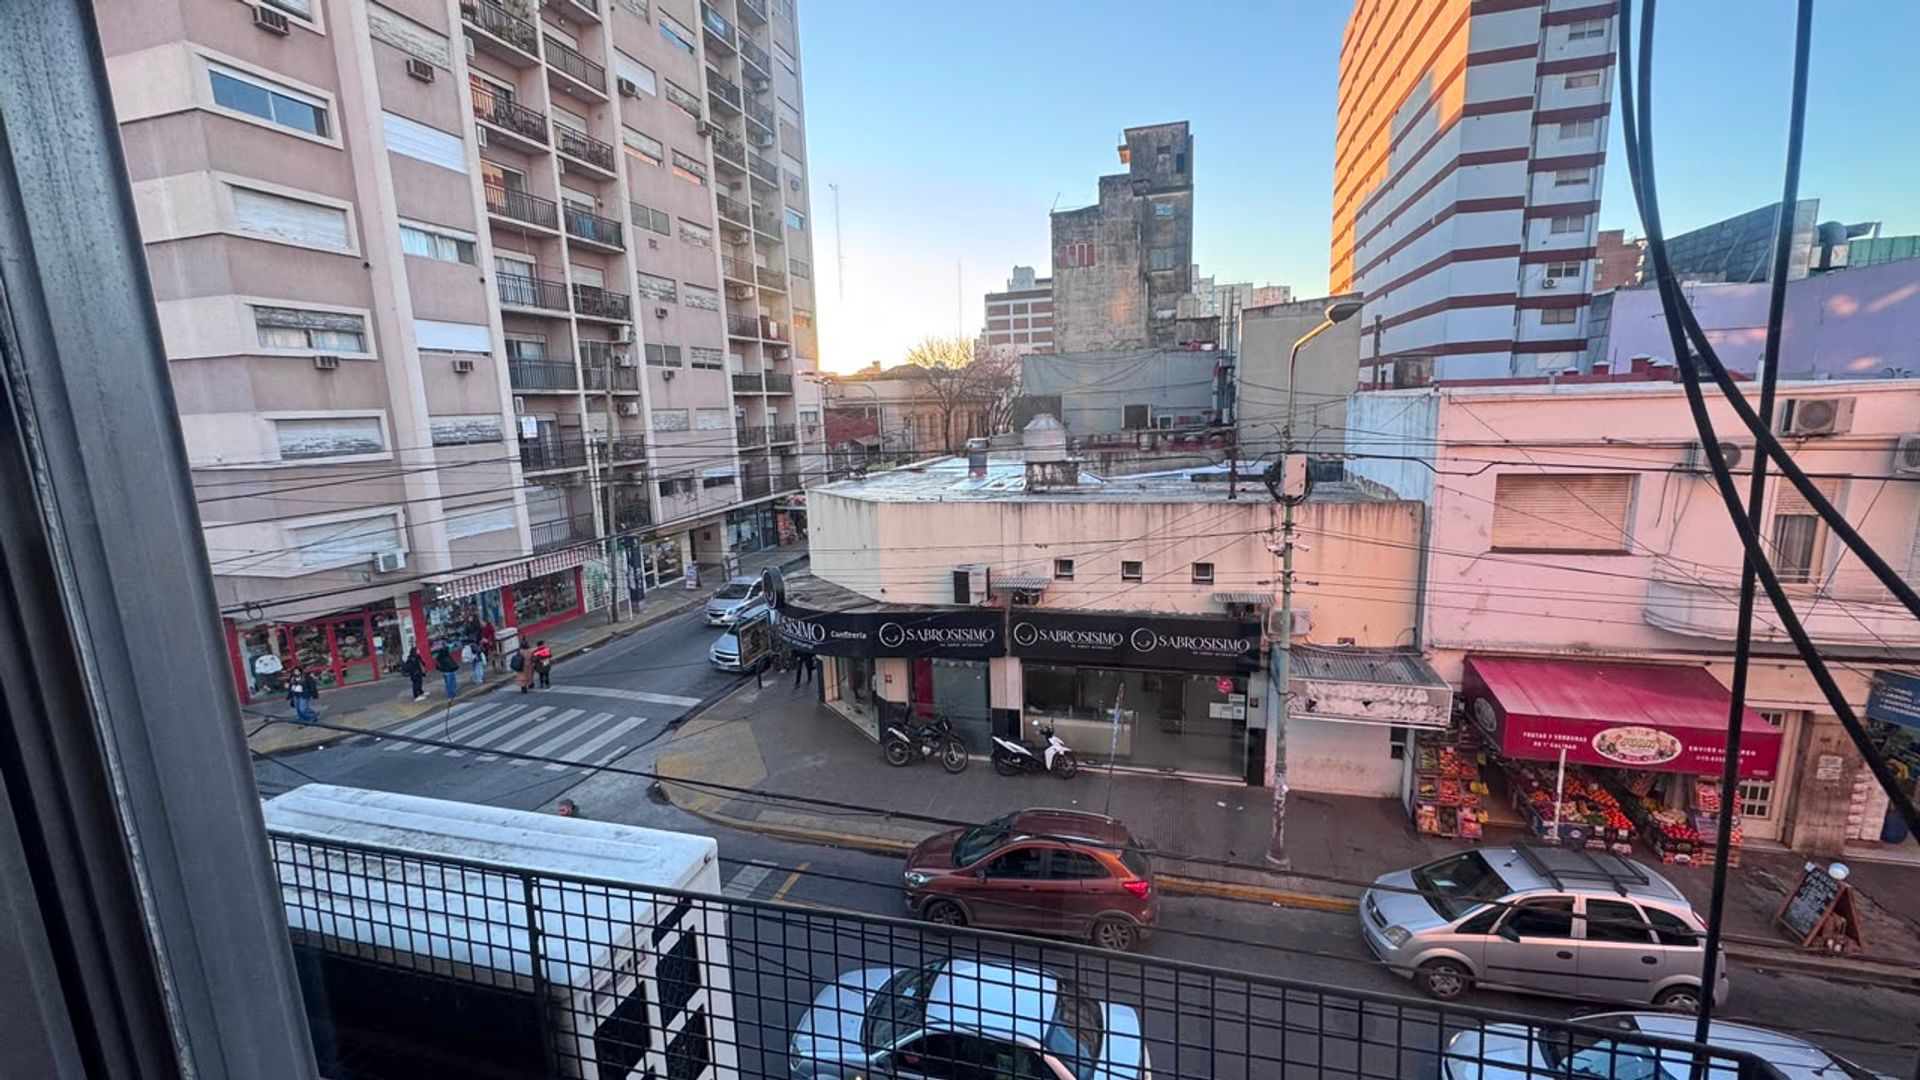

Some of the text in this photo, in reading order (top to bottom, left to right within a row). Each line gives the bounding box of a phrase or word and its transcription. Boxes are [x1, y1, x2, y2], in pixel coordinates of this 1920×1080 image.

[906, 628, 995, 642] SABROSISIMO
[1039, 629, 1124, 646] SABROSISIMO
[1159, 635, 1250, 653] SABROSISIMO
